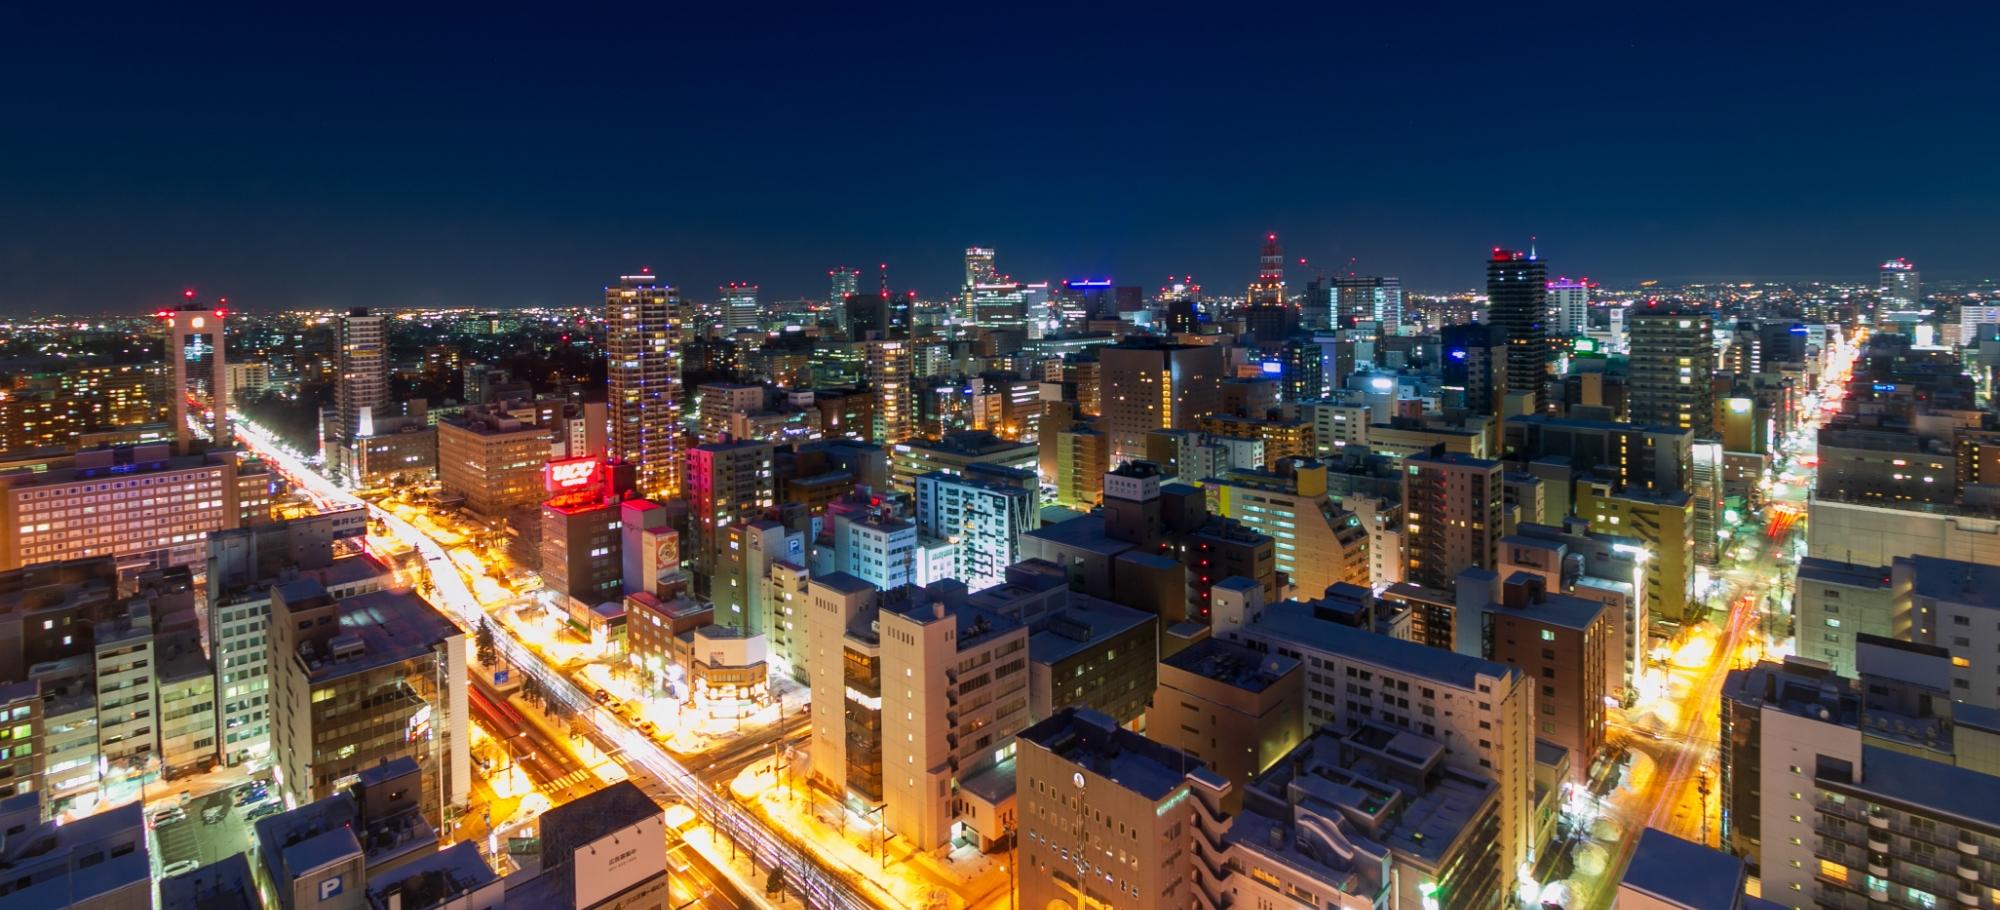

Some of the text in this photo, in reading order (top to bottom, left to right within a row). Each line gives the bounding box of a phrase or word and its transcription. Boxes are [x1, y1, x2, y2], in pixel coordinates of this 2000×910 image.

[552, 461, 596, 481] UCC
[790, 539, 799, 551] P
[321, 877, 341, 900] P
